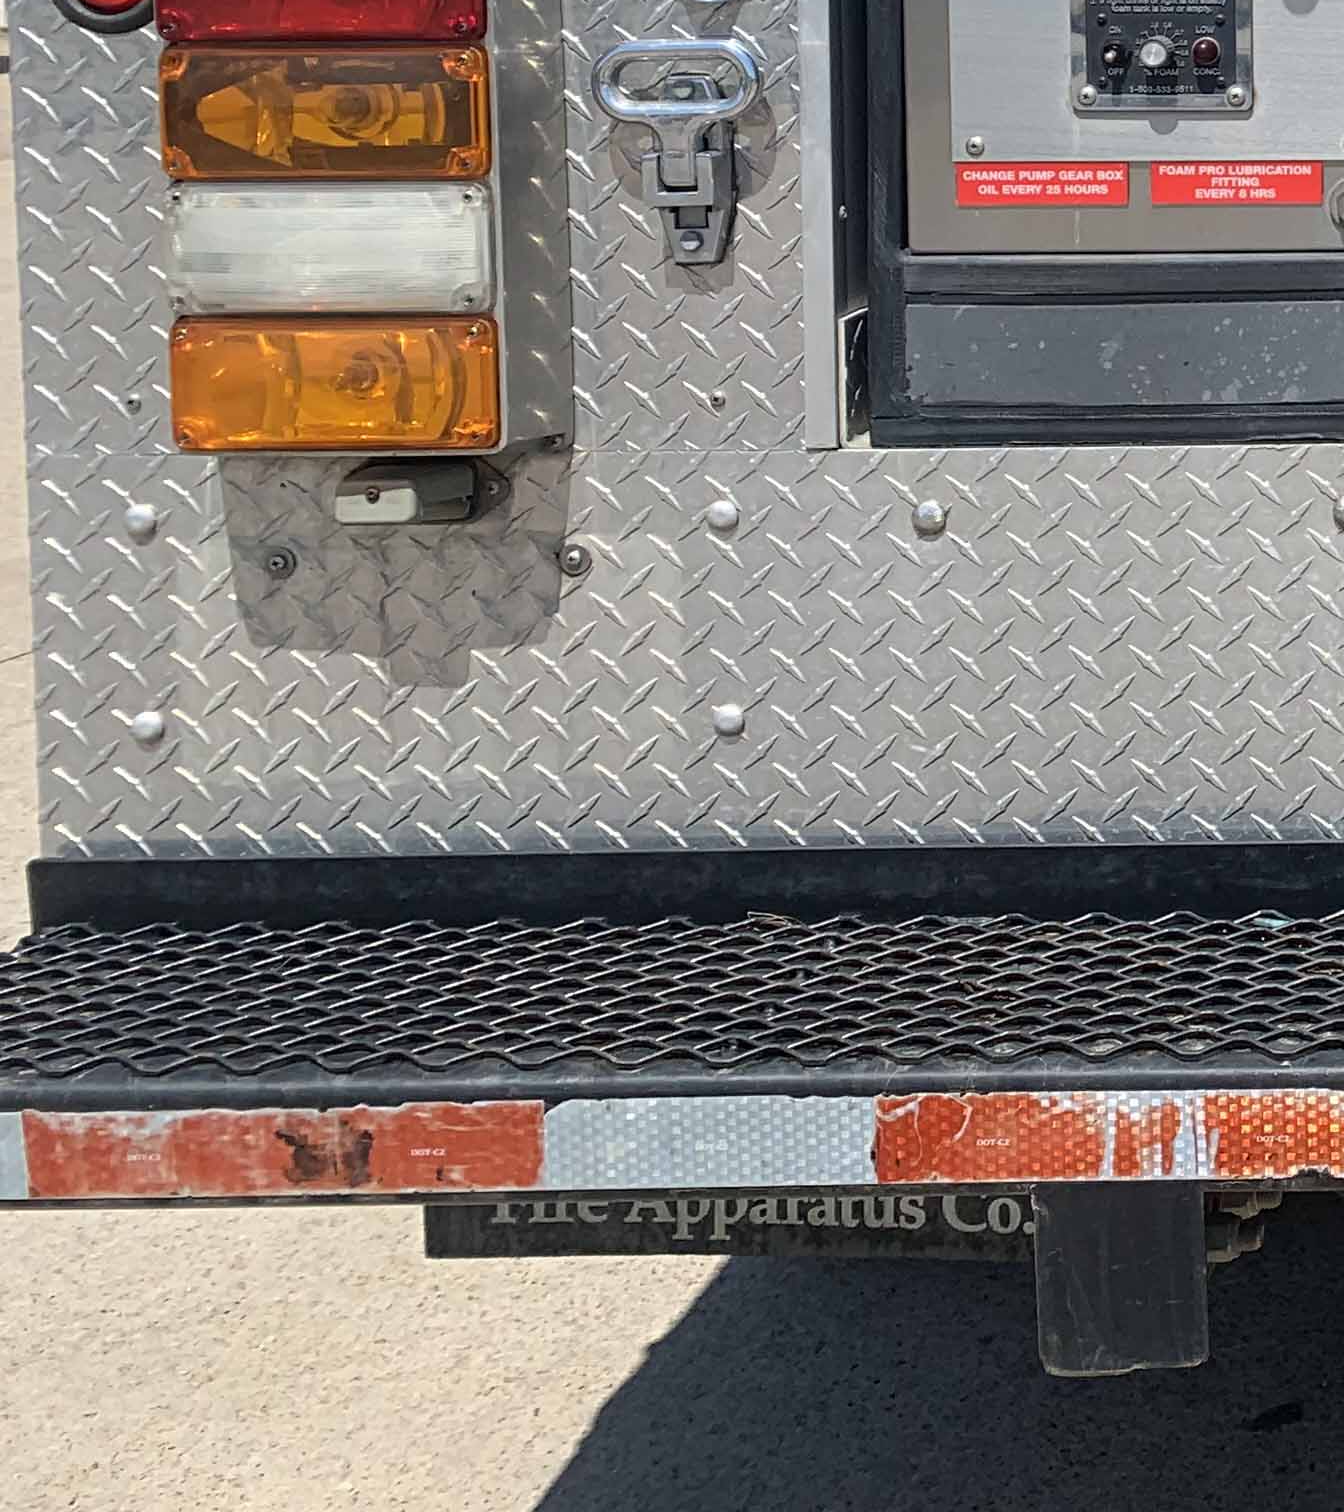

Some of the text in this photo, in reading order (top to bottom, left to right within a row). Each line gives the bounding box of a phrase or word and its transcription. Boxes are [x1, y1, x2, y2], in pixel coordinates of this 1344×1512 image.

[1195, 26, 1216, 34] LOW
[1108, 68, 1124, 76] OFF
[963, 170, 1123, 181] CHANGE PUMP GEAR BOX
[1158, 165, 1312, 176] FOAM PRO LUBRICATION
[1211, 177, 1260, 187] FITTING
[978, 184, 1108, 194] OIL EVERY 25 HOURS
[1195, 189, 1235, 199] EVERY
[1250, 189, 1276, 199] HRS
[624, 1196, 927, 1241] Apparatus
[942, 1194, 1036, 1234] Co.
